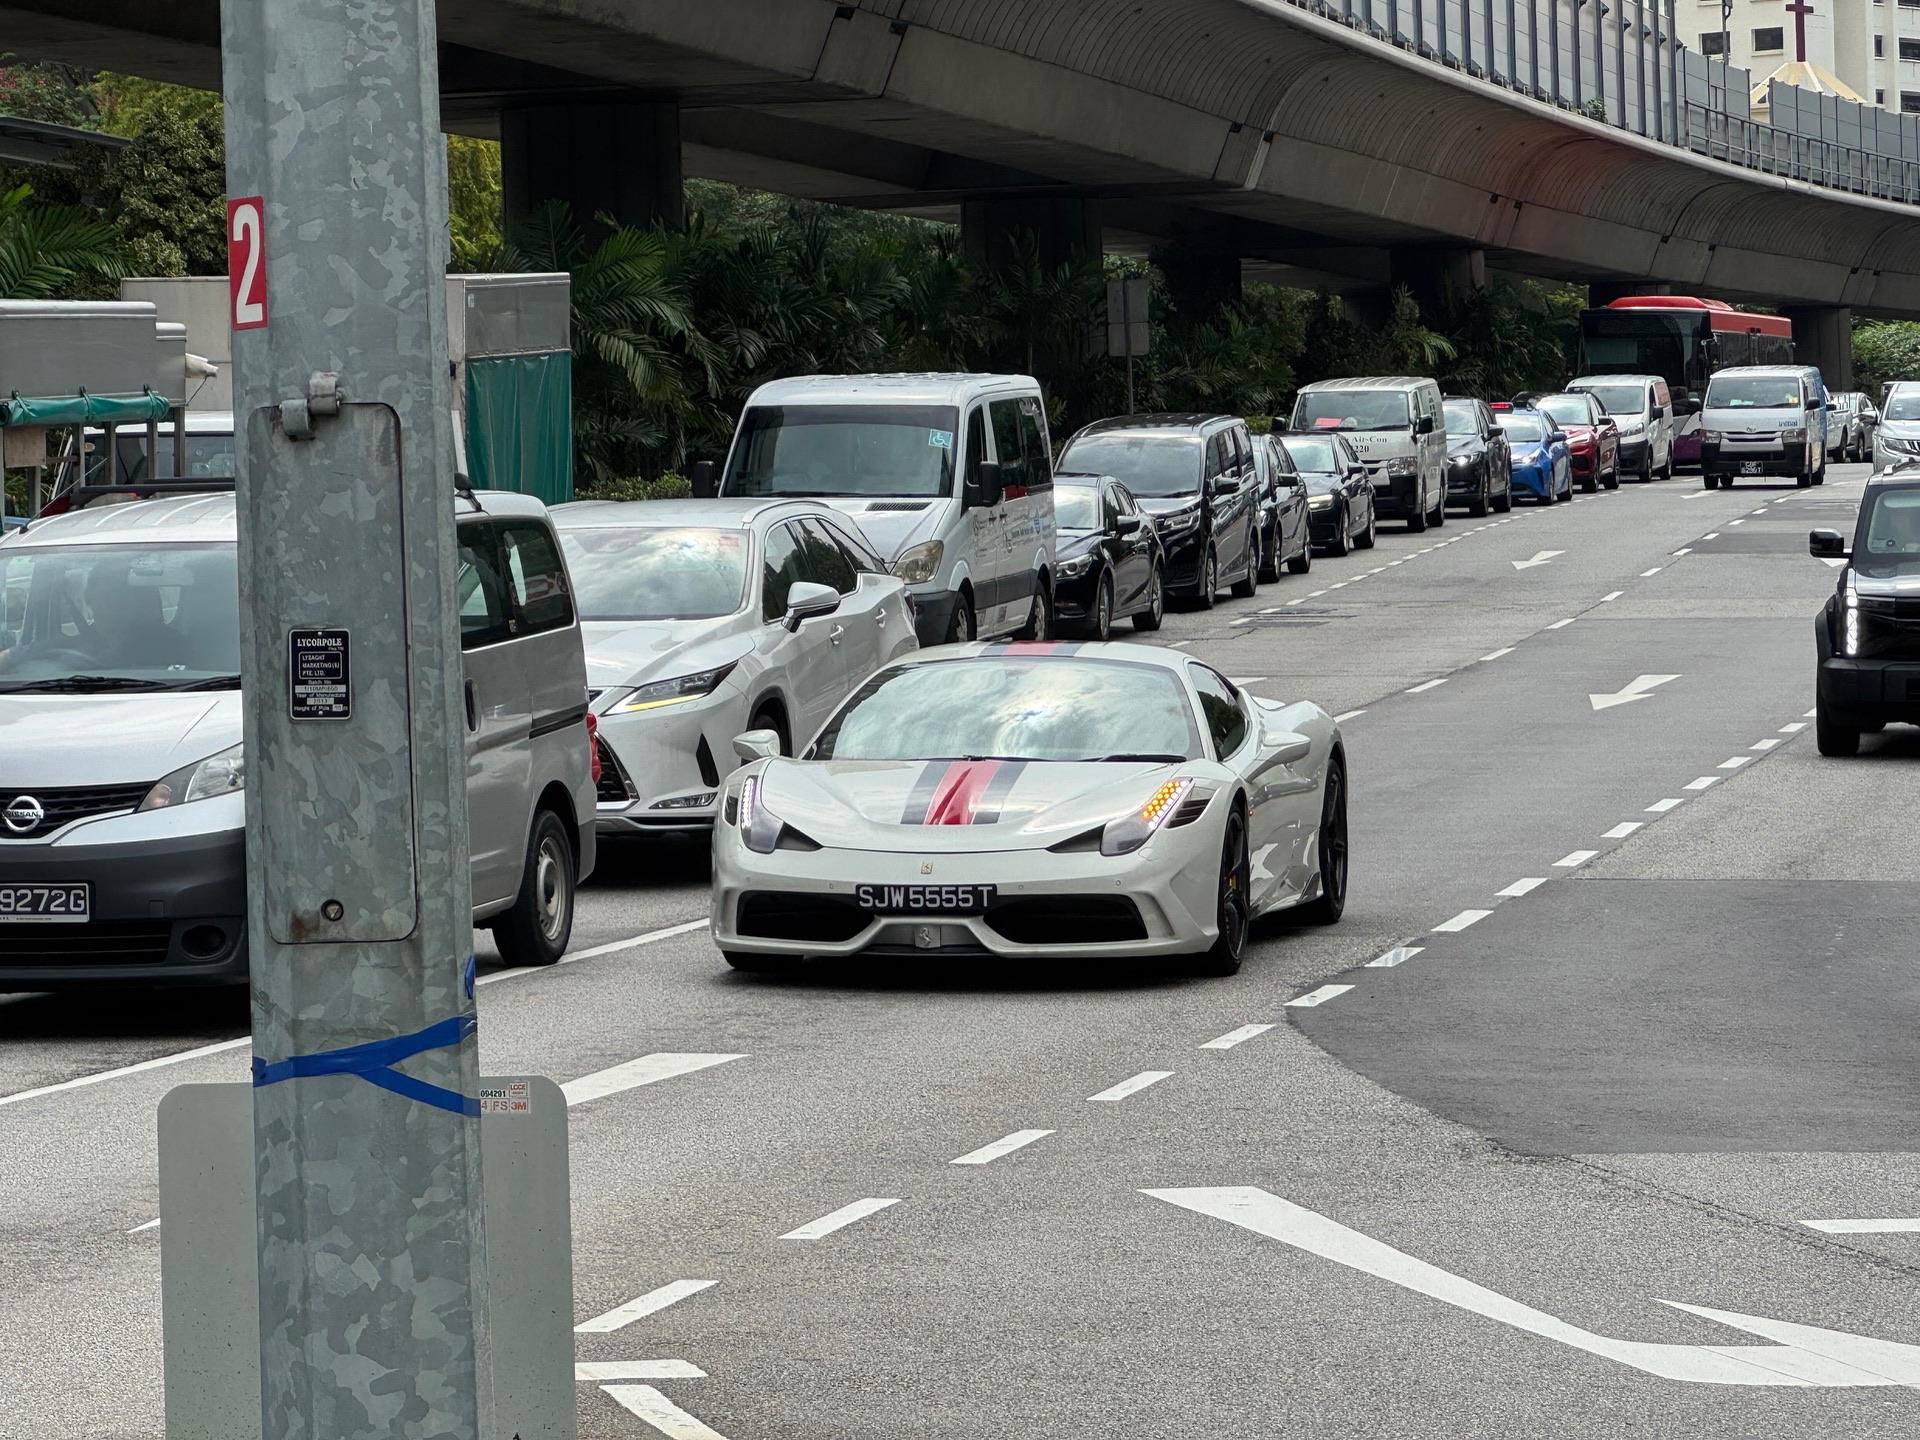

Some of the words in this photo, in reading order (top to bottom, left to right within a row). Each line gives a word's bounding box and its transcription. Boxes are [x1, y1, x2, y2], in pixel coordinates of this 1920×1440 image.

[233, 203, 263, 324] 2
[297, 638, 342, 647] LYCORPOLE
[0, 889, 85, 912] 9272G
[493, 1101, 508, 1111] FS
[511, 1101, 527, 1111] 3M
